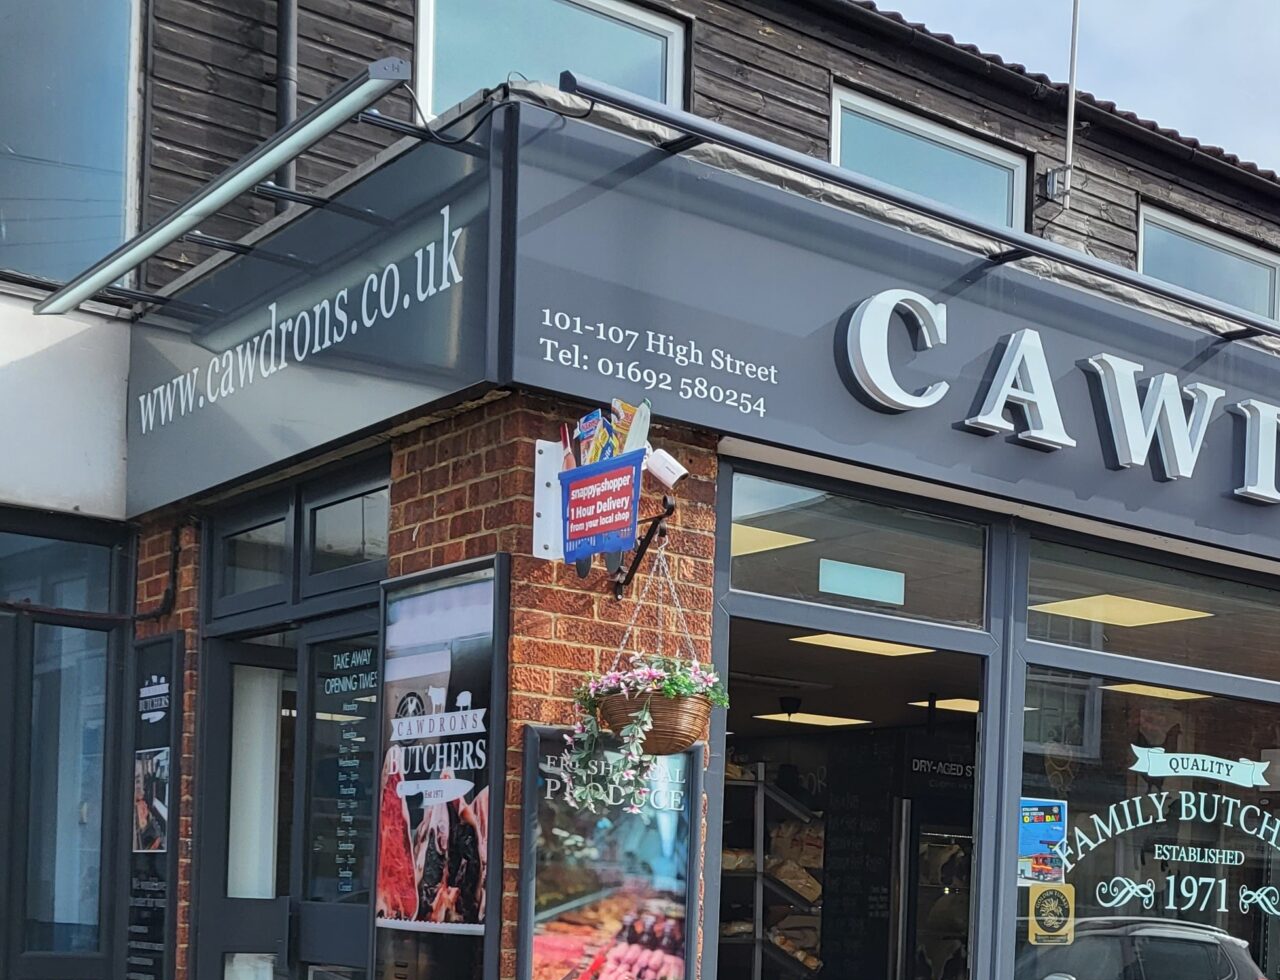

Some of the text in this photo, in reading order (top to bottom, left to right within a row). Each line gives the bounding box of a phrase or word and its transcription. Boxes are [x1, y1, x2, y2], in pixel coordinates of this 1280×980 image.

[138, 205, 463, 434] www.cawdrons.co.uk
[541, 308, 779, 384] 101-107 High Street
[539, 337, 766, 418] Tel: 01692 580254
[571, 475, 630, 500] snappy shopper
[576, 505, 595, 519] Hour
[596, 496, 630, 514] Delivery
[570, 511, 630, 532] from your local shop
[333, 648, 373, 670] TAKE AWAY
[324, 673, 358, 695] OPENING
[397, 713, 479, 737] CAWDRONS
[388, 739, 486, 775] BUTCHERS
[912, 758, 963, 776] DRY-AGED
[1169, 757, 1234, 777] QUALITY
[1023, 814, 1060, 823] OPEN DAY
[1052, 791, 1168, 873] FAMILY
[1154, 844, 1245, 866] ESTABLISHED
[1164, 875, 1229, 912] 1971
